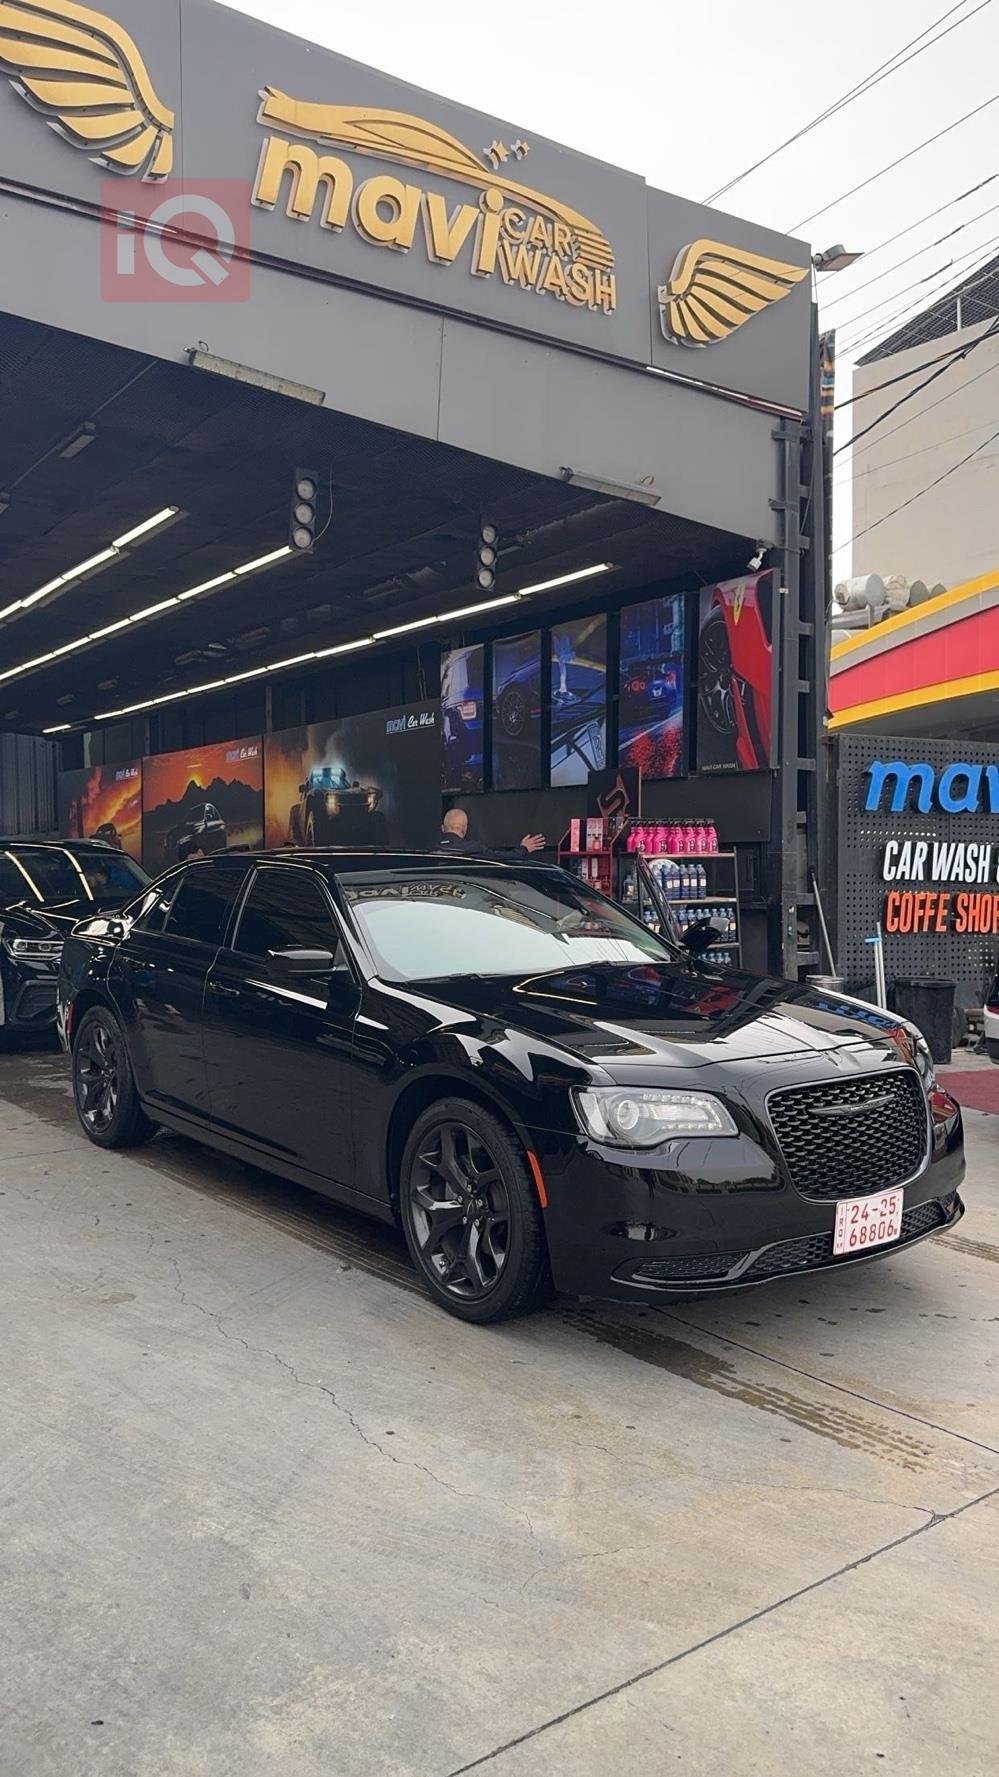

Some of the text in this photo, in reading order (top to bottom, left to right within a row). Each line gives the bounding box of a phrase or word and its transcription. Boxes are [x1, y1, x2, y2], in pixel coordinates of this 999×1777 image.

[252, 136, 503, 276] mavi
[502, 207, 572, 258] CAR
[499, 239, 616, 313] WASH
[883, 841, 927, 881] CAR
[931, 842, 990, 883] WASH
[885, 891, 950, 933] COFFE
[850, 1195, 897, 1225] 24-25
[849, 1219, 895, 1247] 68806
